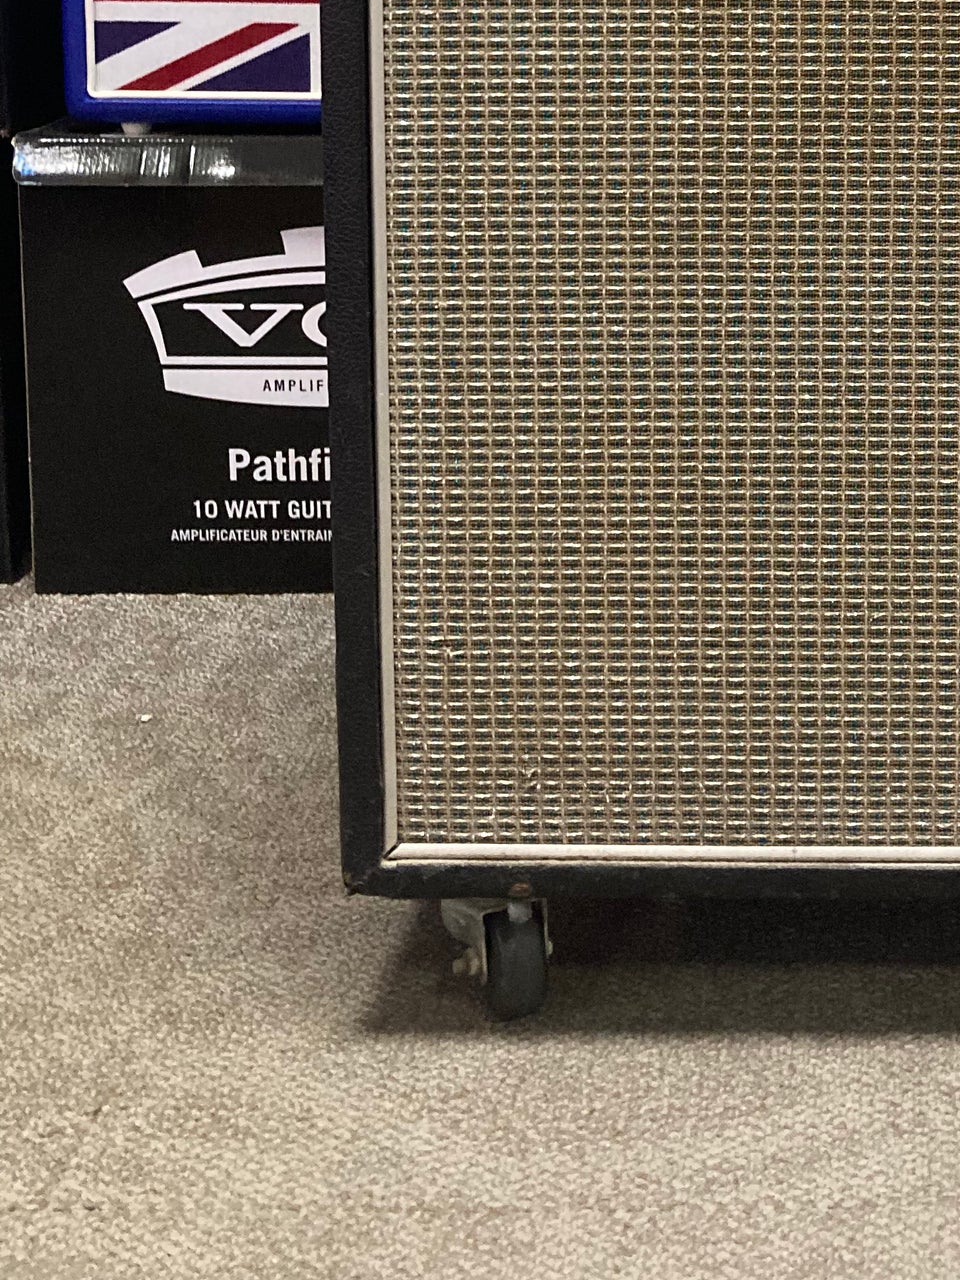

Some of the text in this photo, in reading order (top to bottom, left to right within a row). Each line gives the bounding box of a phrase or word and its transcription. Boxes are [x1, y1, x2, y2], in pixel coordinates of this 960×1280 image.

[262, 379, 324, 392] AMPLIF
[228, 447, 331, 482] Pathfi
[193, 499, 218, 519] 10
[225, 499, 280, 519] WATT
[170, 528, 268, 542] AMPLIFICATEUR
